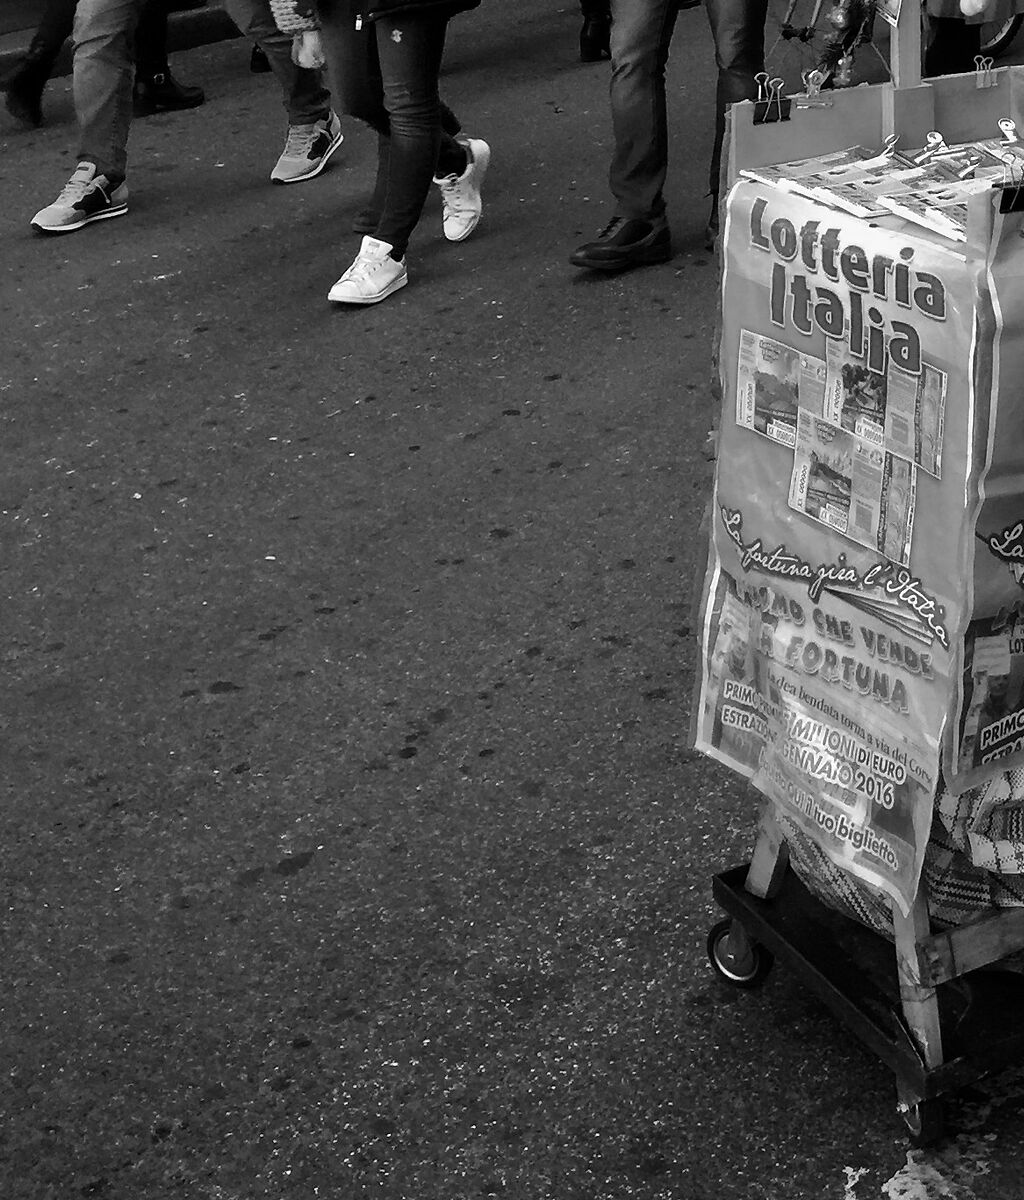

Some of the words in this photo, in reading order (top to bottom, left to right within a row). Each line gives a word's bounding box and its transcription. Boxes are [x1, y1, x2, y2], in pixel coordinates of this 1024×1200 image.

[750, 197, 948, 321] Lotteria
[769, 261, 923, 376] Italia
[721, 507, 743, 546] La
[743, 541, 812, 577] fortuna
[808, 552, 857, 599] gira
[785, 636, 909, 715] FORTUNA
[812, 607, 855, 647] CHE
[860, 626, 934, 680] VENDE
[776, 676, 796, 696] dea
[799, 685, 840, 722] bendata
[840, 711, 866, 741] torna
[867, 735, 873, 745] a
[874, 736, 891, 756] via
[892, 745, 907, 766] del
[782, 741, 852, 783] GENNAIO
[855, 771, 894, 805] 2016
[857, 746, 870, 767] DI
[872, 756, 905, 782] EURO
[814, 805, 834, 831] tuo
[837, 813, 898, 868] biglietto.
